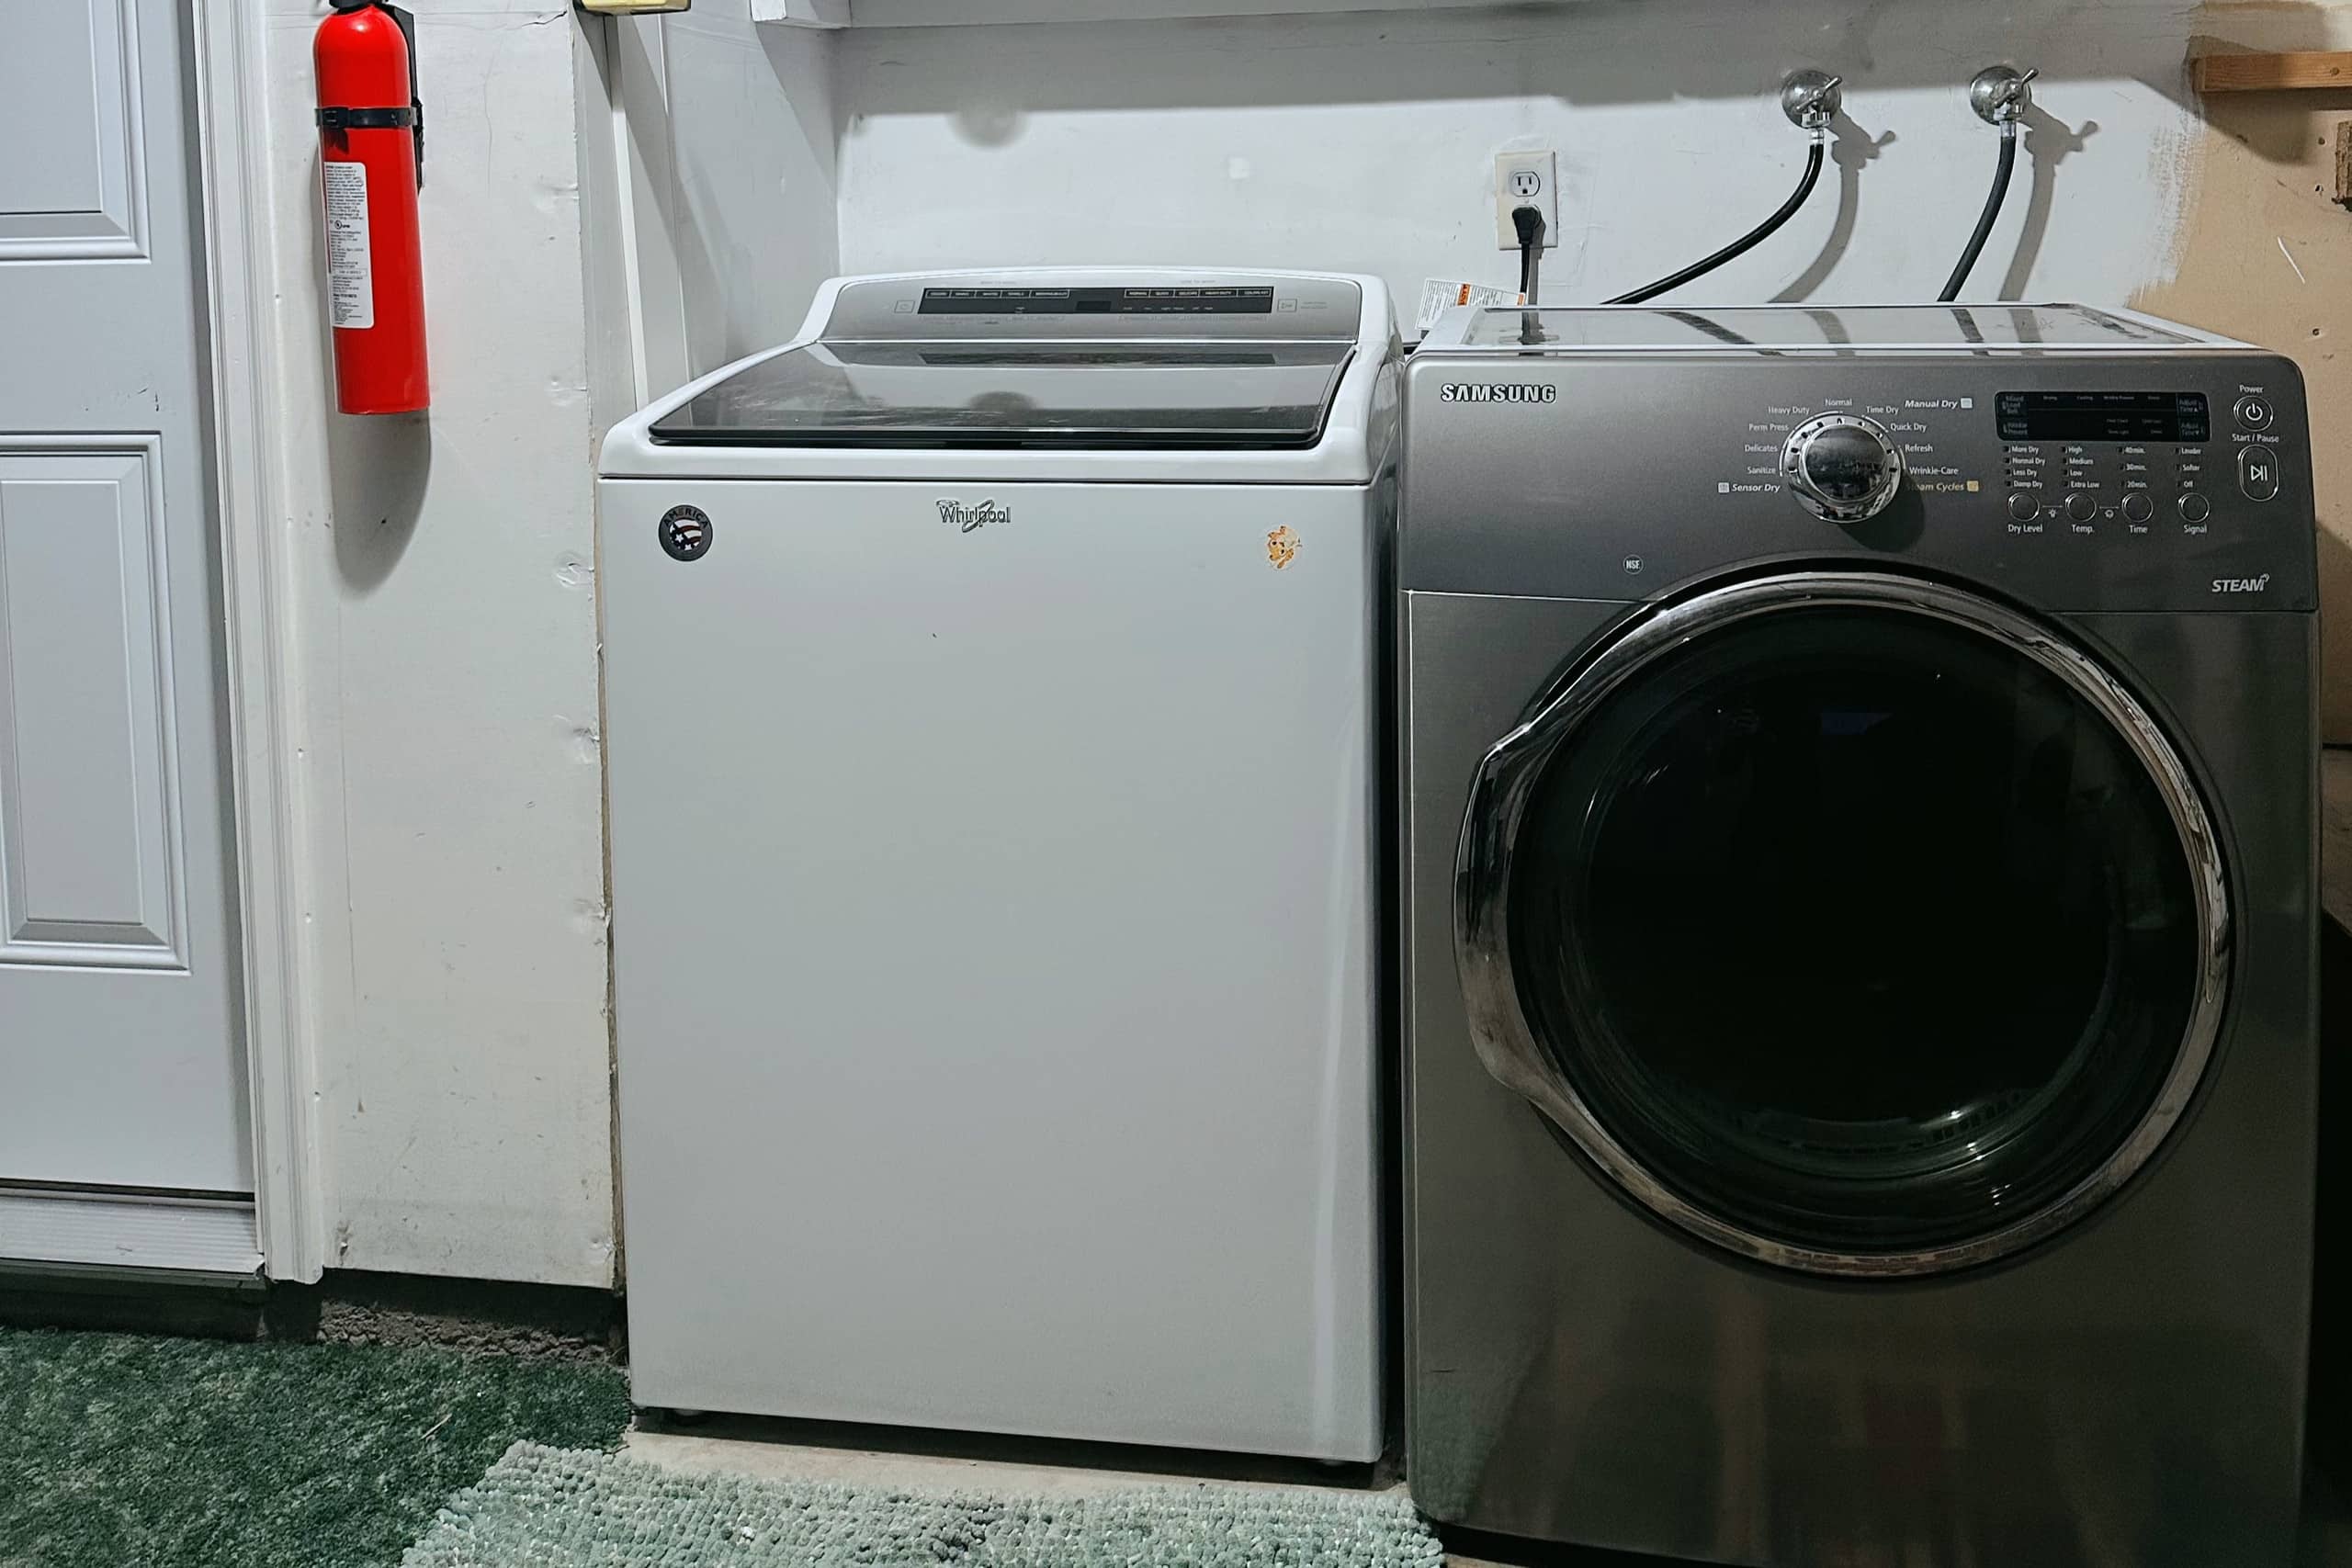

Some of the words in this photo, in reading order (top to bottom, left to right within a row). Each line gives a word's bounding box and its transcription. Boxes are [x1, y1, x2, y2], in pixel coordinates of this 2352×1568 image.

[1441, 383, 1555, 403] SAMSUNG
[2239, 385, 2264, 393] Power
[1825, 398, 1852, 406] Normal
[1905, 400, 1939, 408] Manual
[1940, 400, 1958, 409] Dry
[1768, 406, 1791, 415] Heavy
[1792, 406, 1810, 415] Duty
[1886, 405, 1899, 415] Dry
[1890, 423, 1912, 432] Quick
[1914, 423, 1928, 433] Dry
[2232, 434, 2250, 442] Start
[2257, 434, 2278, 443] Pause
[1905, 444, 1933, 452] Refresh
[2029, 446, 2039, 455] Dry
[2068, 446, 2083, 455] High
[2035, 457, 2045, 467] Dry
[1747, 466, 1776, 474] Sanitize
[1909, 466, 1959, 475] Wrinkle-Care
[2027, 468, 2037, 478] Dry
[1764, 483, 1781, 492] Dry
[1936, 482, 1964, 492] Cycles
[2013, 480, 2031, 489] Damp
[2032, 480, 2043, 490] Dry
[936, 501, 1012, 532] Whirlpool
[2007, 524, 2021, 535] Dry
[2023, 524, 2043, 532] Level
[2072, 525, 2094, 535] Temp.
[2129, 525, 2148, 533] Time
[2183, 525, 2207, 535] Signal
[2211, 577, 2267, 592] STEAM
